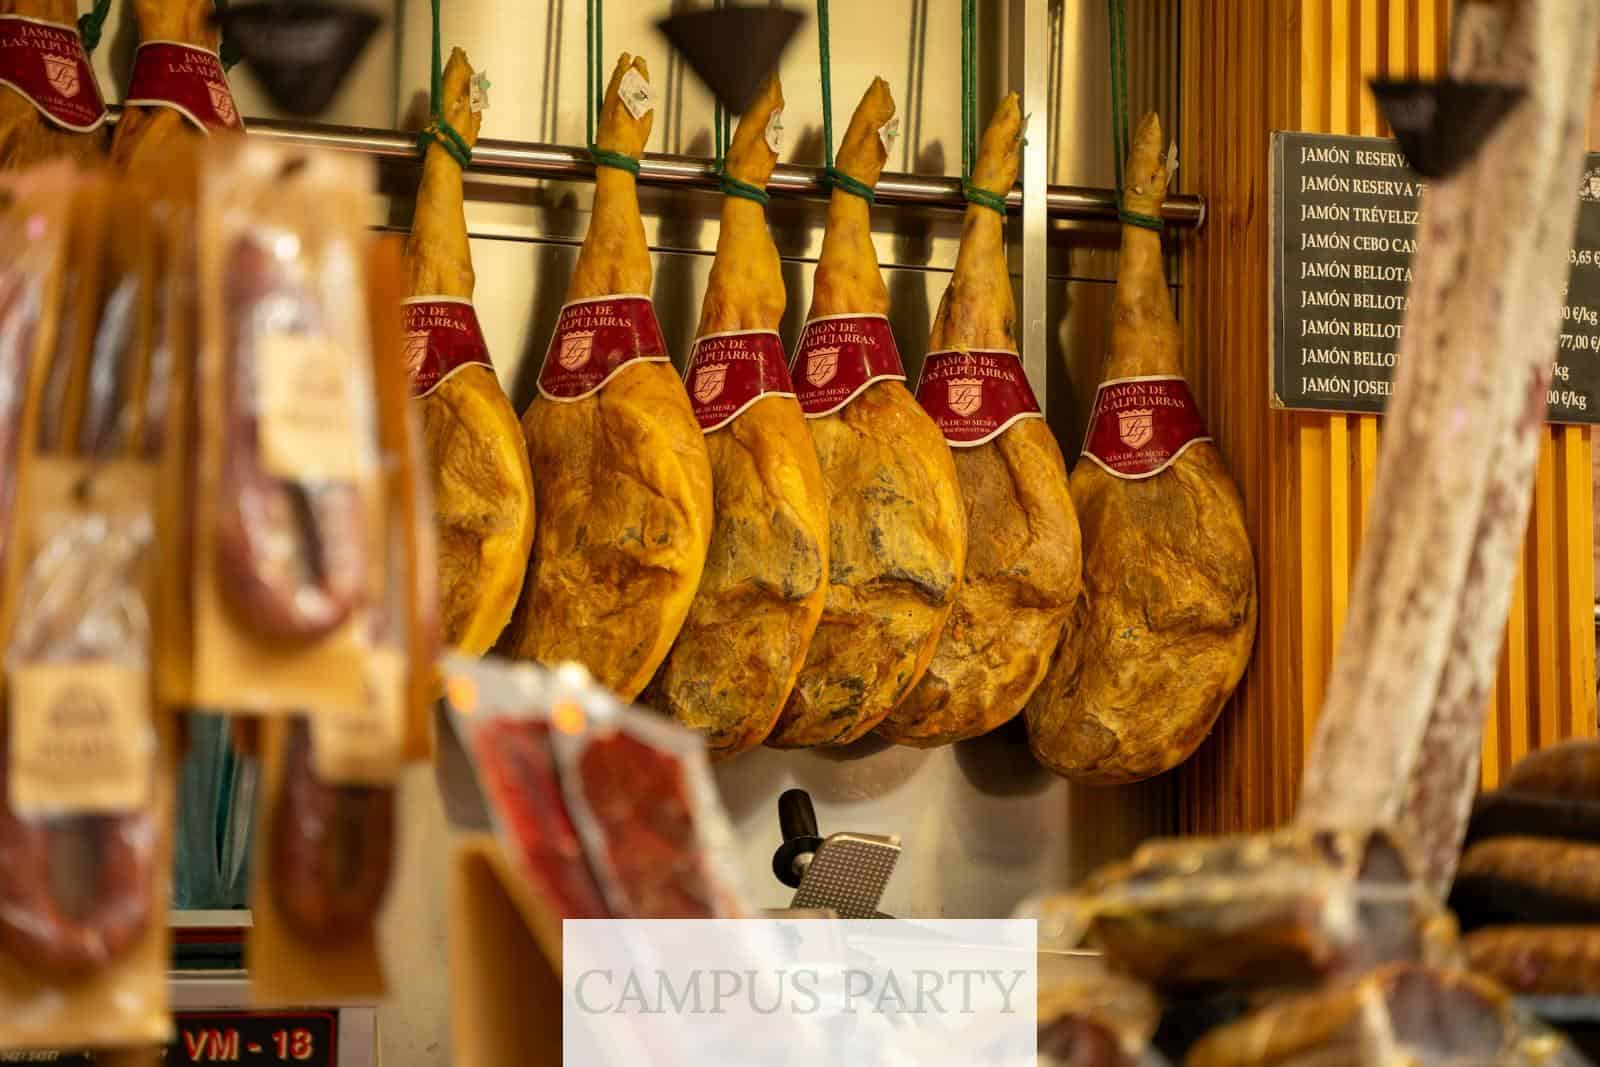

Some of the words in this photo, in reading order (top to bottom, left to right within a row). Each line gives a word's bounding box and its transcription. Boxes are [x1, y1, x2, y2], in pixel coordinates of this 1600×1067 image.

[1301, 145, 1350, 165] JAMÓN
[1355, 150, 1410, 168] RESERV
[1301, 174, 1350, 193] JAMÓN
[1352, 178, 1413, 197] RESERVA
[1301, 203, 1350, 222] JAMÓN
[1352, 206, 1420, 225] TRÉVELEZ
[1301, 232, 1350, 251] JAMÓN
[1353, 236, 1389, 252] CEBO
[1301, 260, 1350, 279] JAMÓN
[1353, 264, 1413, 282] BELLOTA
[1301, 289, 1350, 308] JAMÓN
[430, 306, 448, 317] DE
[595, 305, 614, 316] DE
[1572, 308, 1598, 326] €/kg
[403, 316, 467, 331] PUJARRAS
[840, 322, 858, 333] DE
[1301, 318, 1350, 337] JAMÓN
[1353, 321, 1404, 339] BELLOT
[729, 339, 748, 350] DE
[981, 357, 999, 368] DE
[1301, 346, 1350, 365] JAMÓN
[1551, 362, 1569, 381] /kg
[1149, 385, 1168, 396] DE
[1301, 375, 1350, 394] JAMÓN
[1353, 379, 1394, 398] JOSEL
[1111, 396, 1185, 411] ALPUJARRAS
[1561, 391, 1587, 410] €/kg
[183, 1027, 240, 1062] VM
